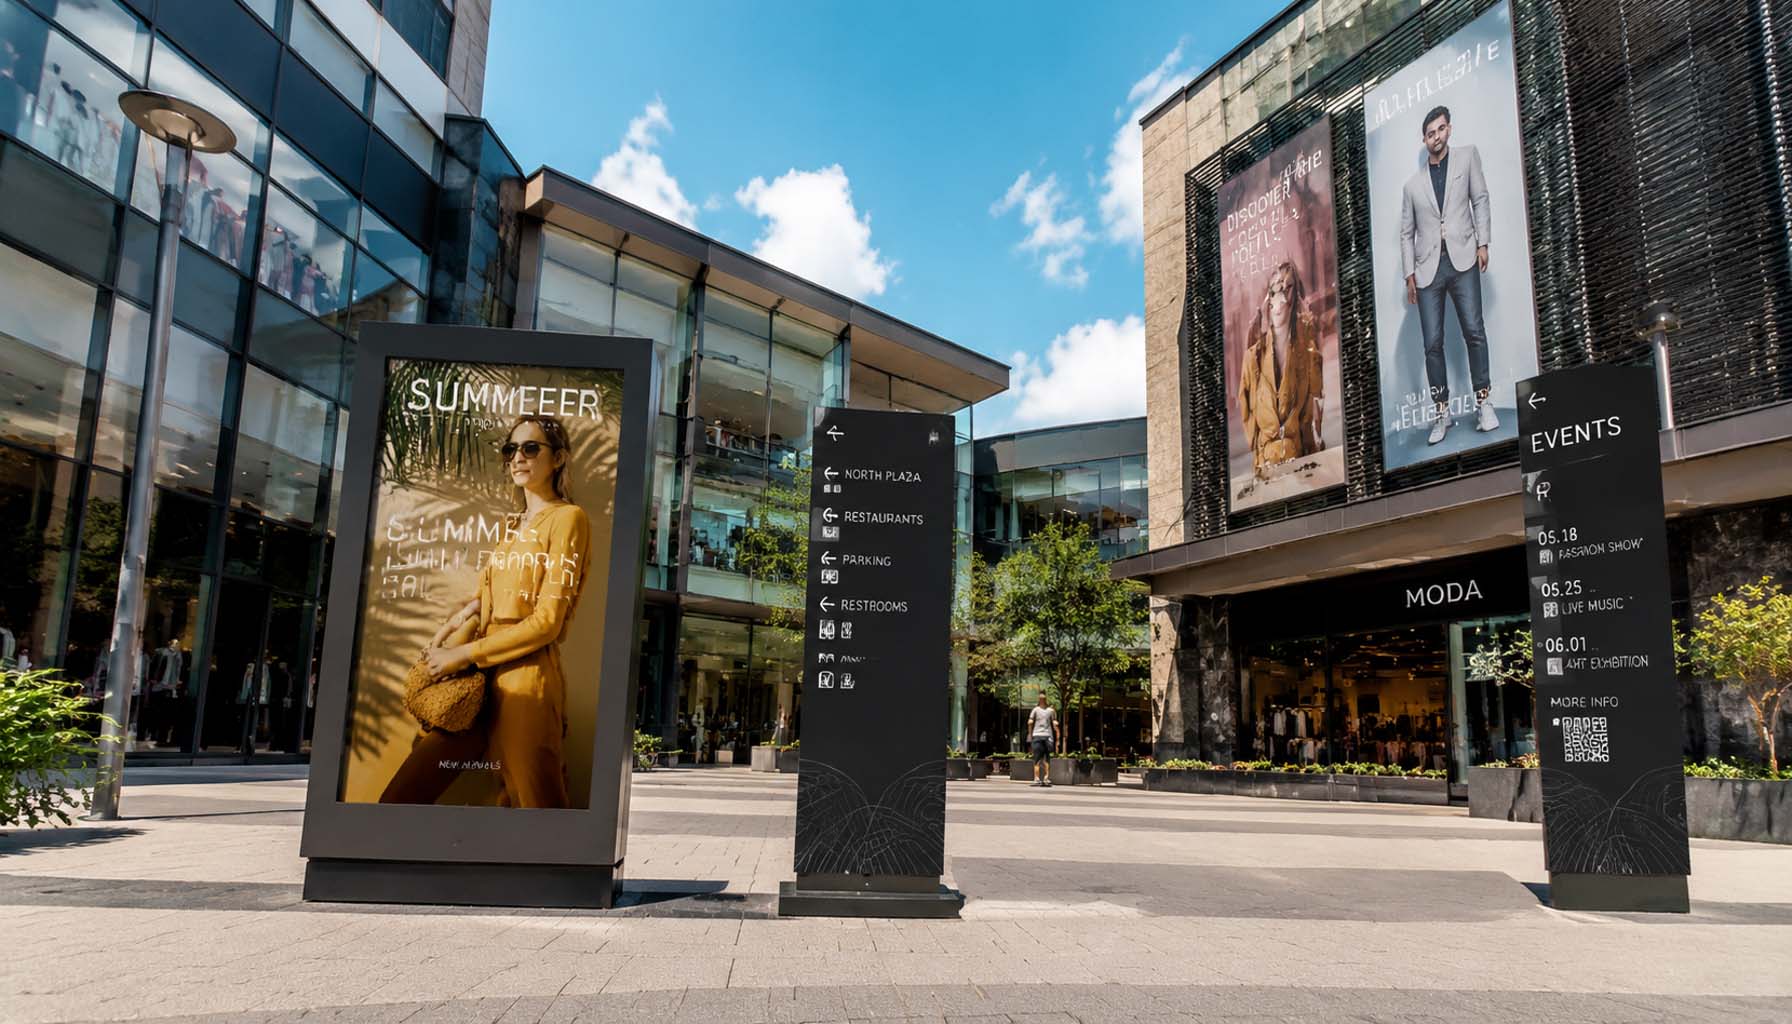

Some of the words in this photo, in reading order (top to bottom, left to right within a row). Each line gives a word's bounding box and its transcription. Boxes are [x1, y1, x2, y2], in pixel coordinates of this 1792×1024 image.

[1531, 416, 1622, 453] EVENTS
[845, 469, 882, 480] NORTH
[886, 471, 921, 482] PLAZA
[844, 511, 924, 525] RESTAURANTS
[1538, 527, 1578, 546] 05.18
[1608, 537, 1643, 553] SHOW
[842, 554, 892, 566] PARKING
[1406, 579, 1484, 608] MODA
[1541, 580, 1582, 597] 05.25
[840, 599, 908, 613] RESTROOMS
[1588, 597, 1624, 611] MUSIC
[1545, 636, 1587, 653] 06.01
[1550, 697, 1587, 708] MORE
[1591, 696, 1619, 708] INFO
